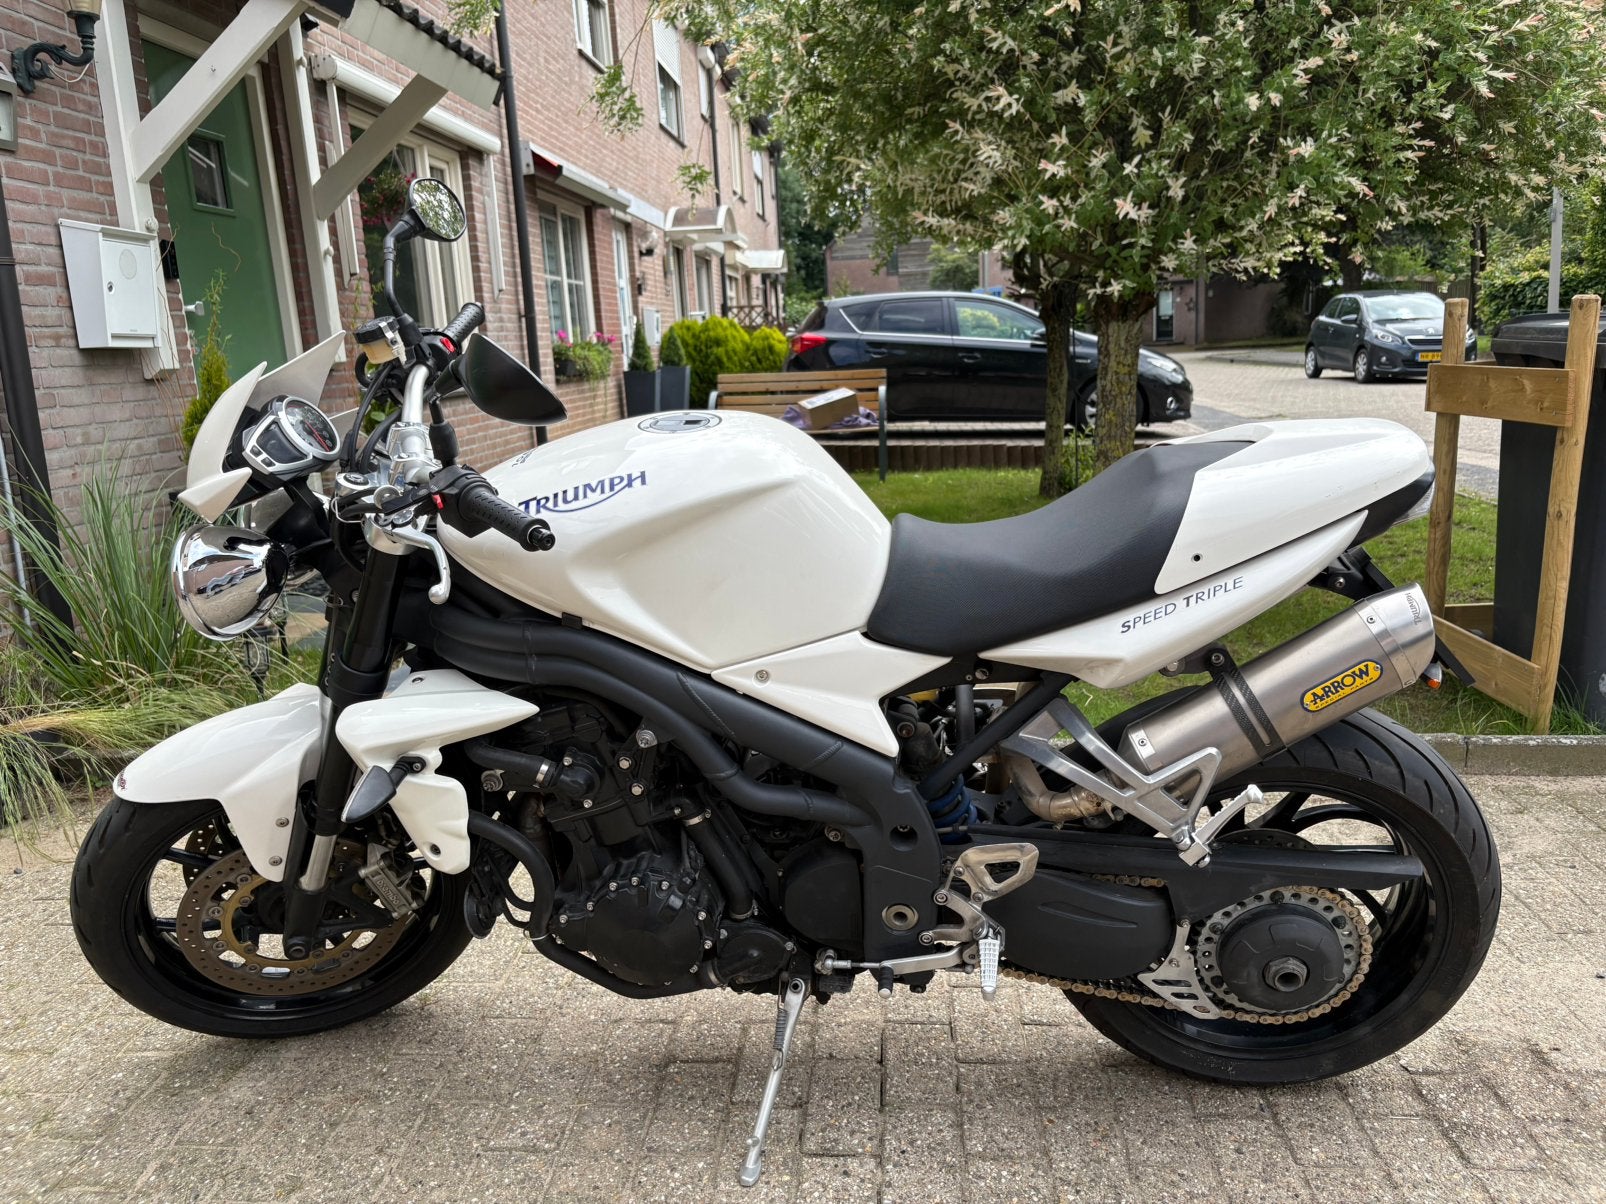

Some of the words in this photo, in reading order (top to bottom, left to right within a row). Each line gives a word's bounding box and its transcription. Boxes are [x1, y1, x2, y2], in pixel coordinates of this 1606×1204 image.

[518, 470, 647, 515] TRIUMPH
[1120, 602, 1177, 634] SPEED
[1182, 576, 1244, 608] TRIPLE
[1405, 592, 1422, 625] TRIUMPH
[1309, 663, 1370, 706] ARROW
[376, 879, 400, 905] brembo
